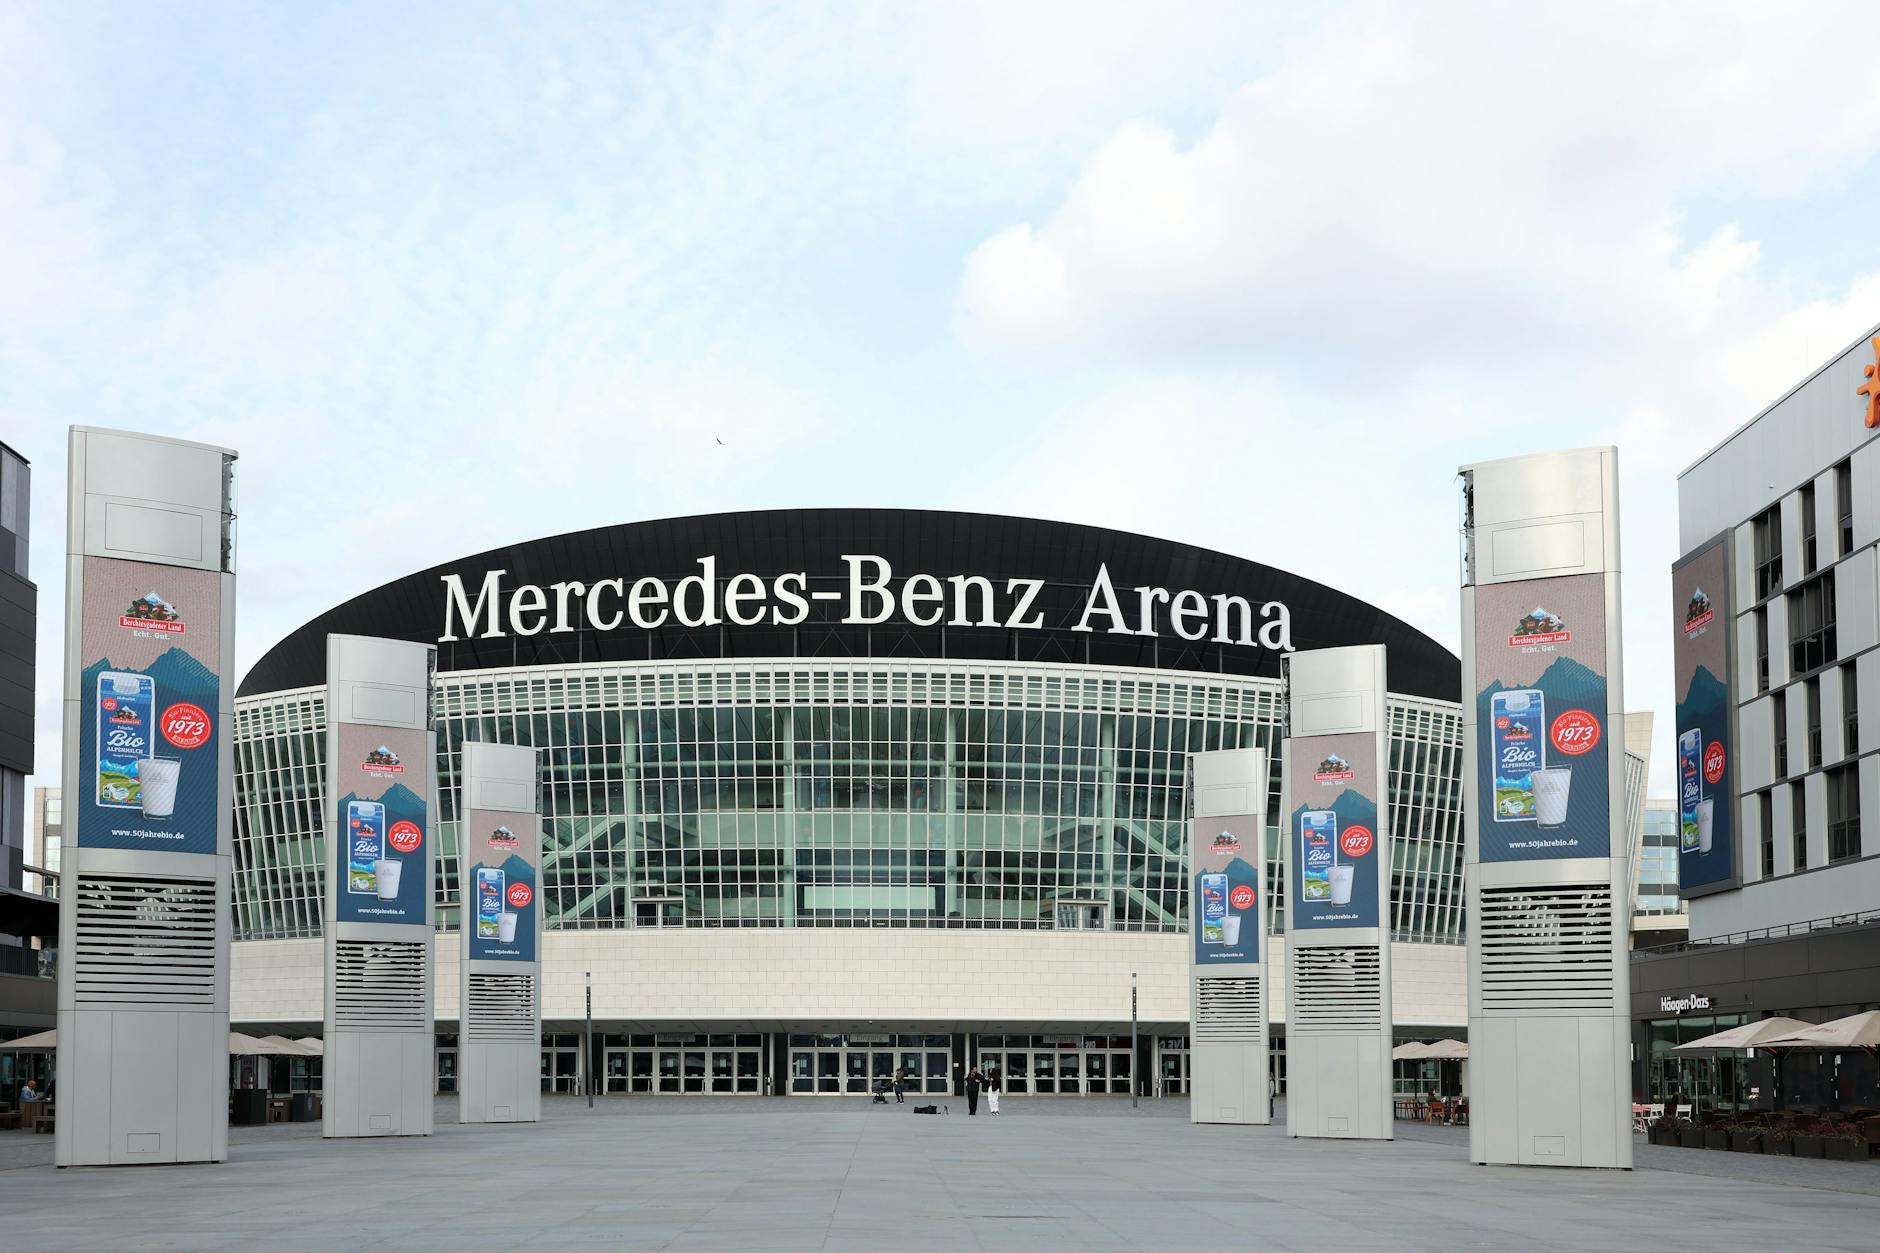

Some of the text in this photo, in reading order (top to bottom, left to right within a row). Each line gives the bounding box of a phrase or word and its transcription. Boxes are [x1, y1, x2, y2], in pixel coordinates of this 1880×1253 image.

[438, 554, 1296, 652] Mercedes-Benz Arena
[167, 623, 182, 632] Land
[1554, 632, 1568, 641] Land
[167, 719, 206, 736] 1973
[107, 729, 145, 748] Bio
[1557, 726, 1594, 742] 1973
[1501, 746, 1537, 763] Bio
[1706, 755, 1723, 773] 1973
[1683, 781, 1700, 799] Bio
[111, 829, 185, 840] www.50jahrebio.de
[393, 832, 418, 844] 1973
[354, 840, 380, 853] Bio
[1344, 836, 1369, 848] 1973
[1508, 838, 1579, 849] www.50jahrebio.de
[1308, 849, 1332, 861] Bio
[511, 891, 530, 900] 1973
[1233, 894, 1252, 903] 1973
[482, 898, 501, 908] Bio
[1206, 903, 1225, 913] Bio
[1660, 993, 1710, 1015] Häagen-Dazs
